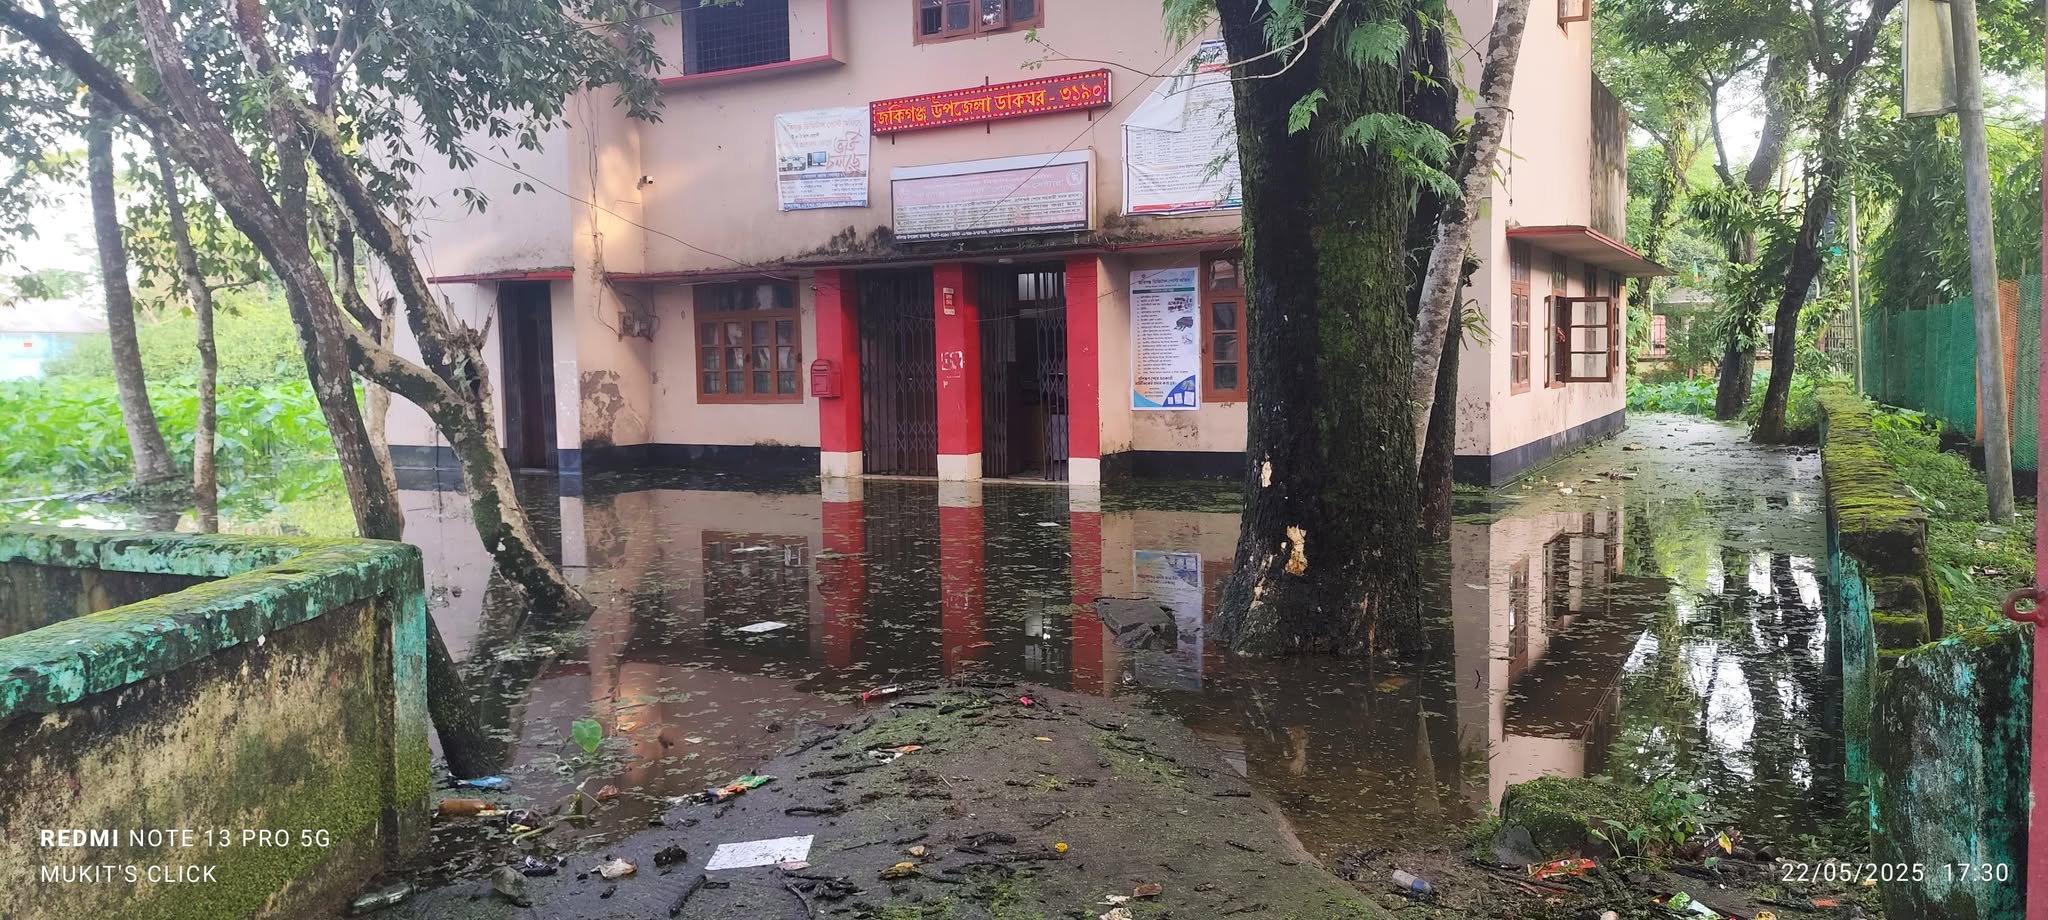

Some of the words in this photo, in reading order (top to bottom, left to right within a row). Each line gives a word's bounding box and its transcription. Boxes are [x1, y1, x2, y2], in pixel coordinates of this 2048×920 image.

[875, 101, 928, 126] জকিগঞ্জ
[931, 94, 991, 118] উপজেলা
[993, 89, 1047, 111] ডাকঘর
[1058, 84, 1103, 102] ৩১৯০
